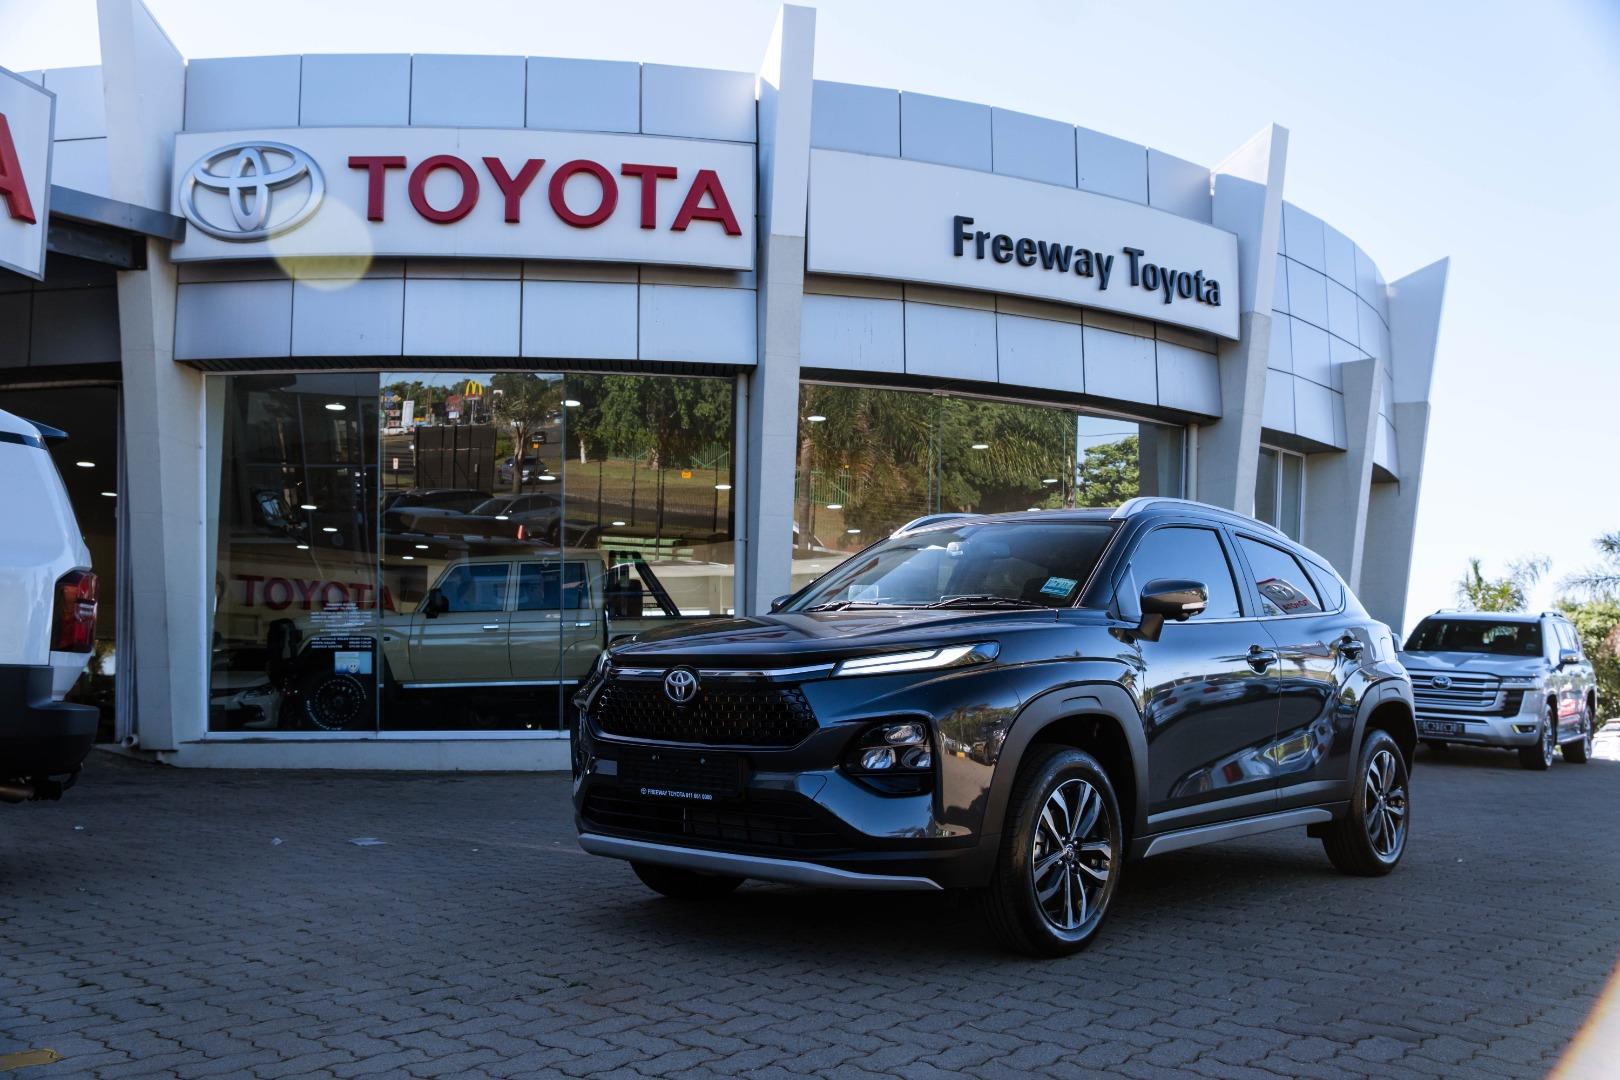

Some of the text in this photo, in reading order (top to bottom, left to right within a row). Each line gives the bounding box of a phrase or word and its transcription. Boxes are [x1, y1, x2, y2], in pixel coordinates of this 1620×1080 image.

[347, 154, 743, 237] TOYOTA
[953, 215, 1221, 307] Freeway Toyota
[668, 790, 686, 798] TOYOTA
